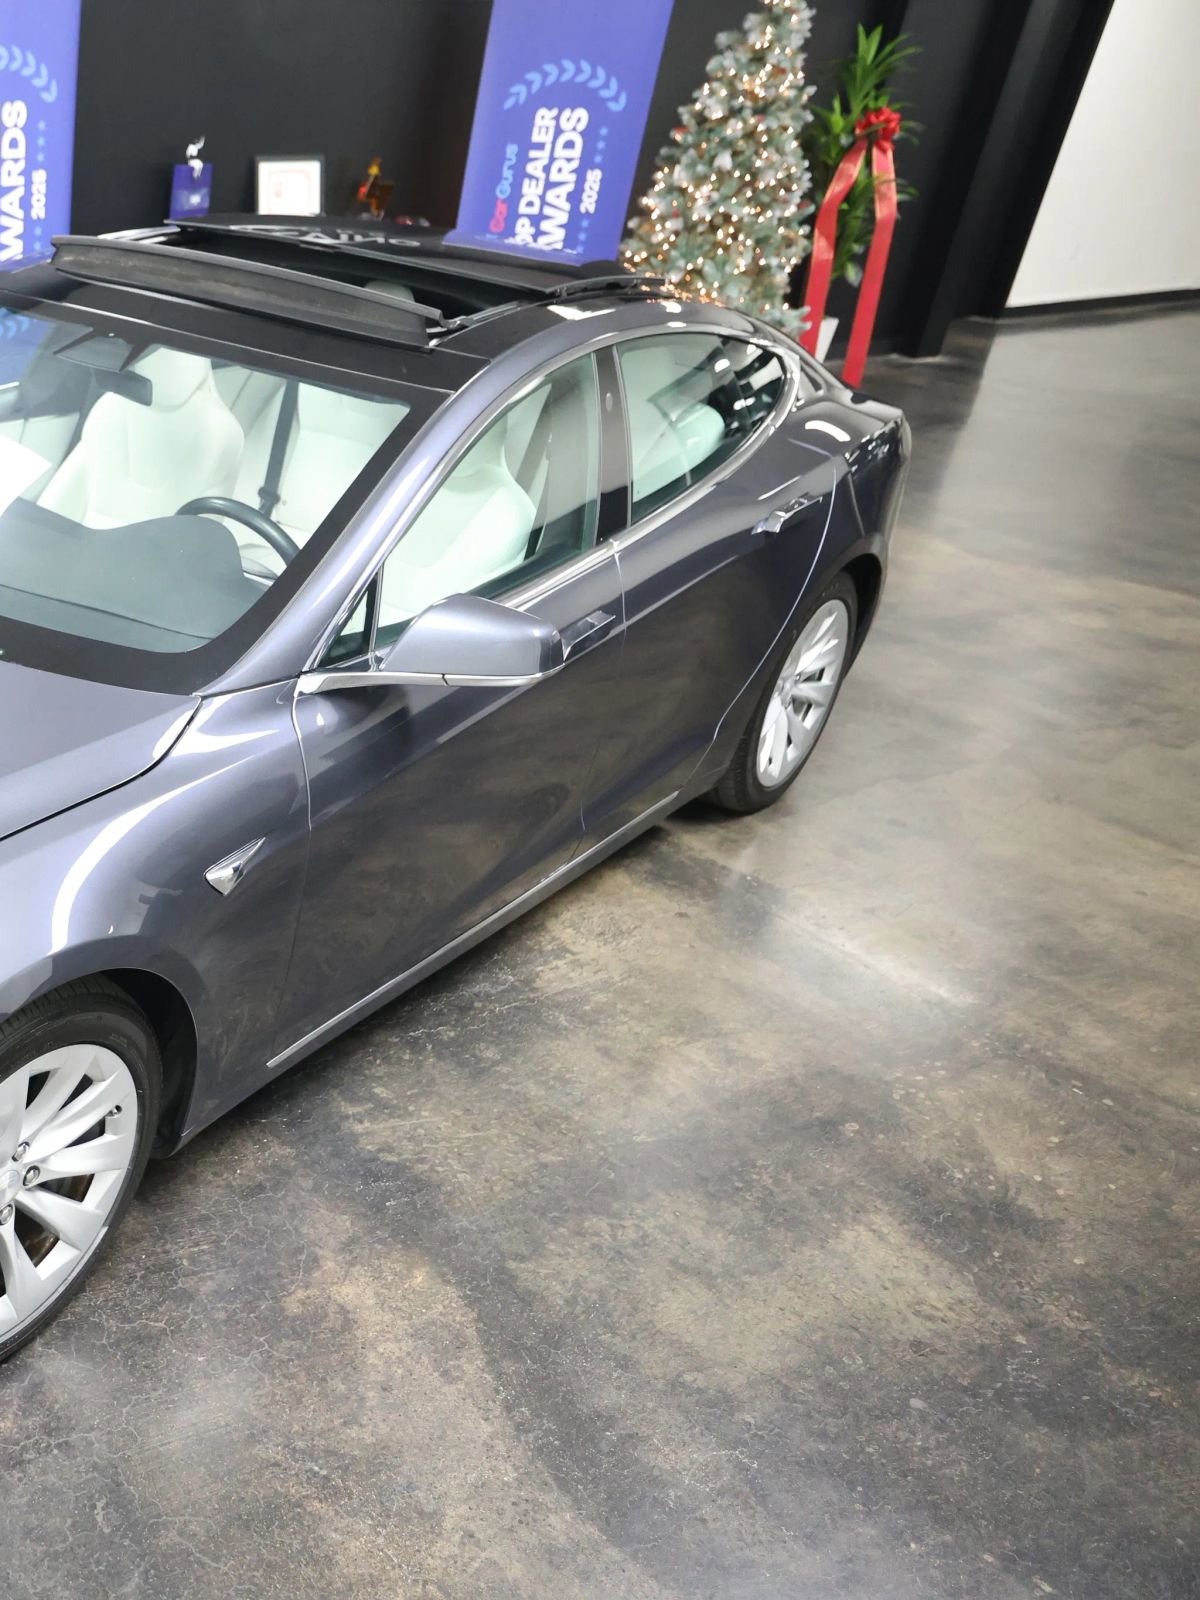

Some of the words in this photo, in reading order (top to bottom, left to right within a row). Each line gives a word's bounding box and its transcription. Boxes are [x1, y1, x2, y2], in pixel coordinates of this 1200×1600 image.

[0, 99, 28, 260] WARDS
[490, 143, 518, 233] CarGurus
[517, 106, 559, 216] DEALER
[534, 106, 590, 250] WARDS
[580, 167, 603, 215] 2025
